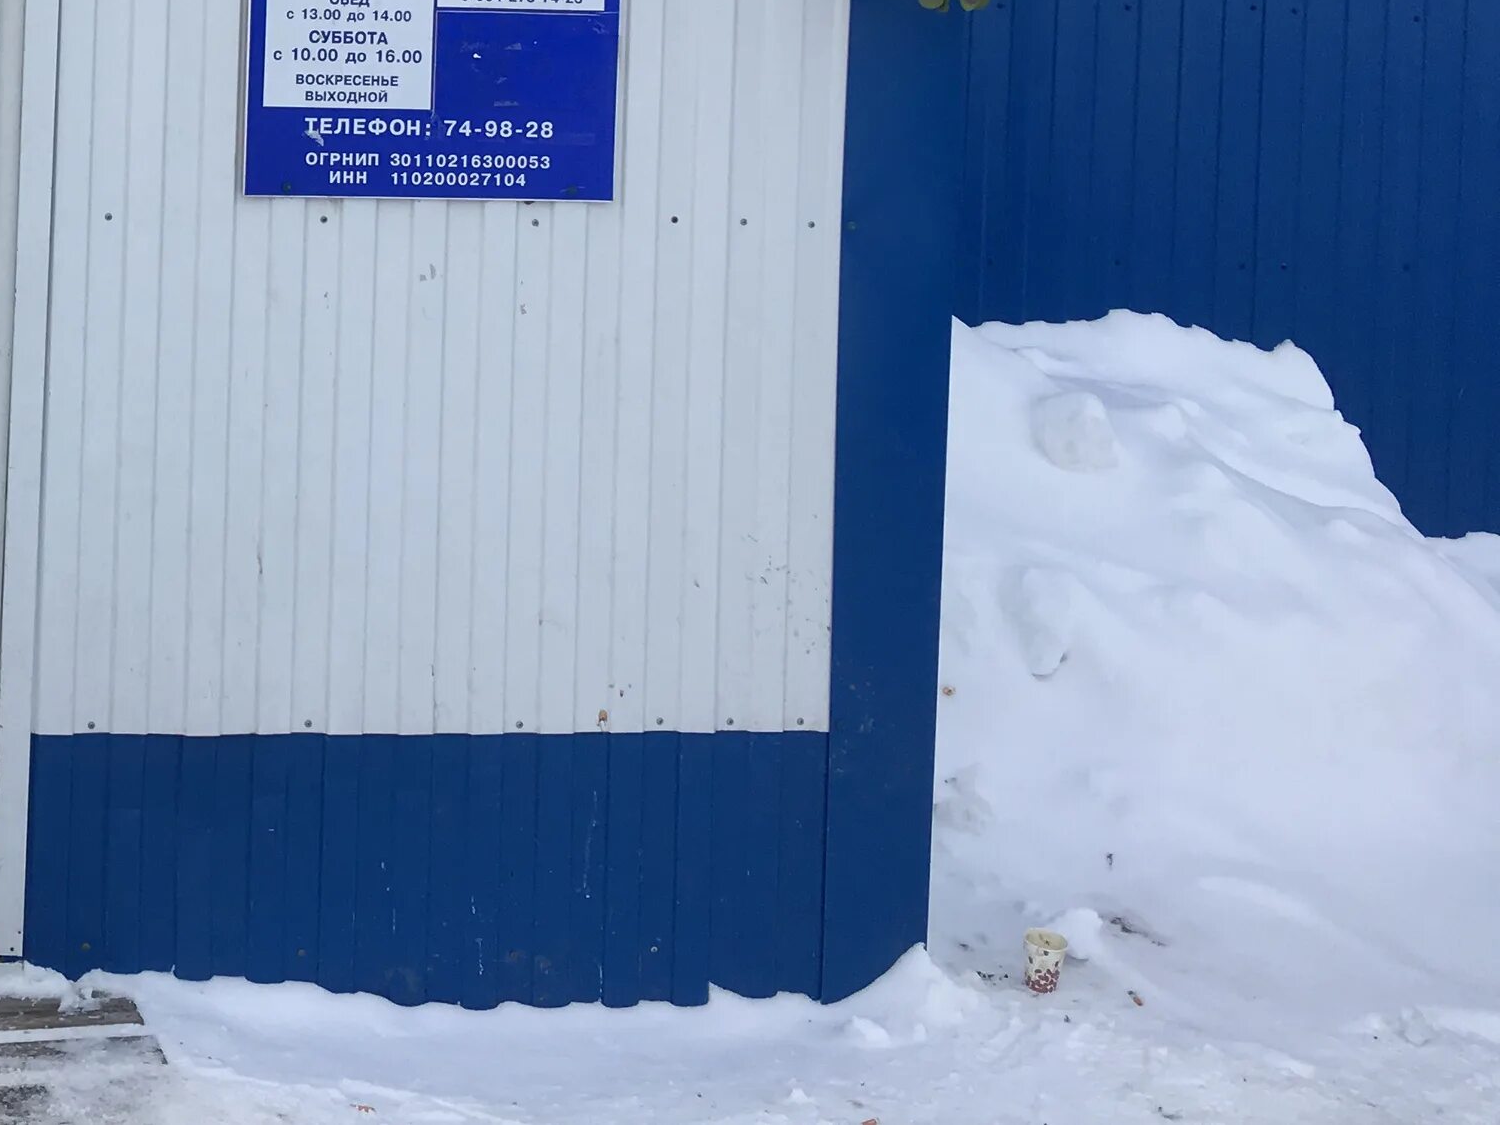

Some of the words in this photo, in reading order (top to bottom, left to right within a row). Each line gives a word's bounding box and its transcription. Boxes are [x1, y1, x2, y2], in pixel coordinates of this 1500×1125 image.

[286, 10, 294, 20] с
[301, 8, 341, 21] 13.00
[347, 11, 365, 23] до
[373, 10, 412, 22] 14.00
[309, 30, 388, 45] СУББОТА
[273, 51, 282, 62] с
[291, 48, 338, 63] 10.00
[345, 51, 367, 64] до
[376, 49, 422, 64] 16.00
[295, 74, 398, 87] ВОСКРЕСЕНЬЕ
[305, 89, 388, 103] ВЫХОДНОЙ
[304, 117, 432, 136] ТЕЛЕФОН:
[443, 120, 554, 138] 74-98-28
[305, 153, 379, 167] ОГРНИП
[390, 153, 551, 169] 30110216300053
[329, 171, 367, 184] ИНН
[391, 172, 526, 187] 110200027104
